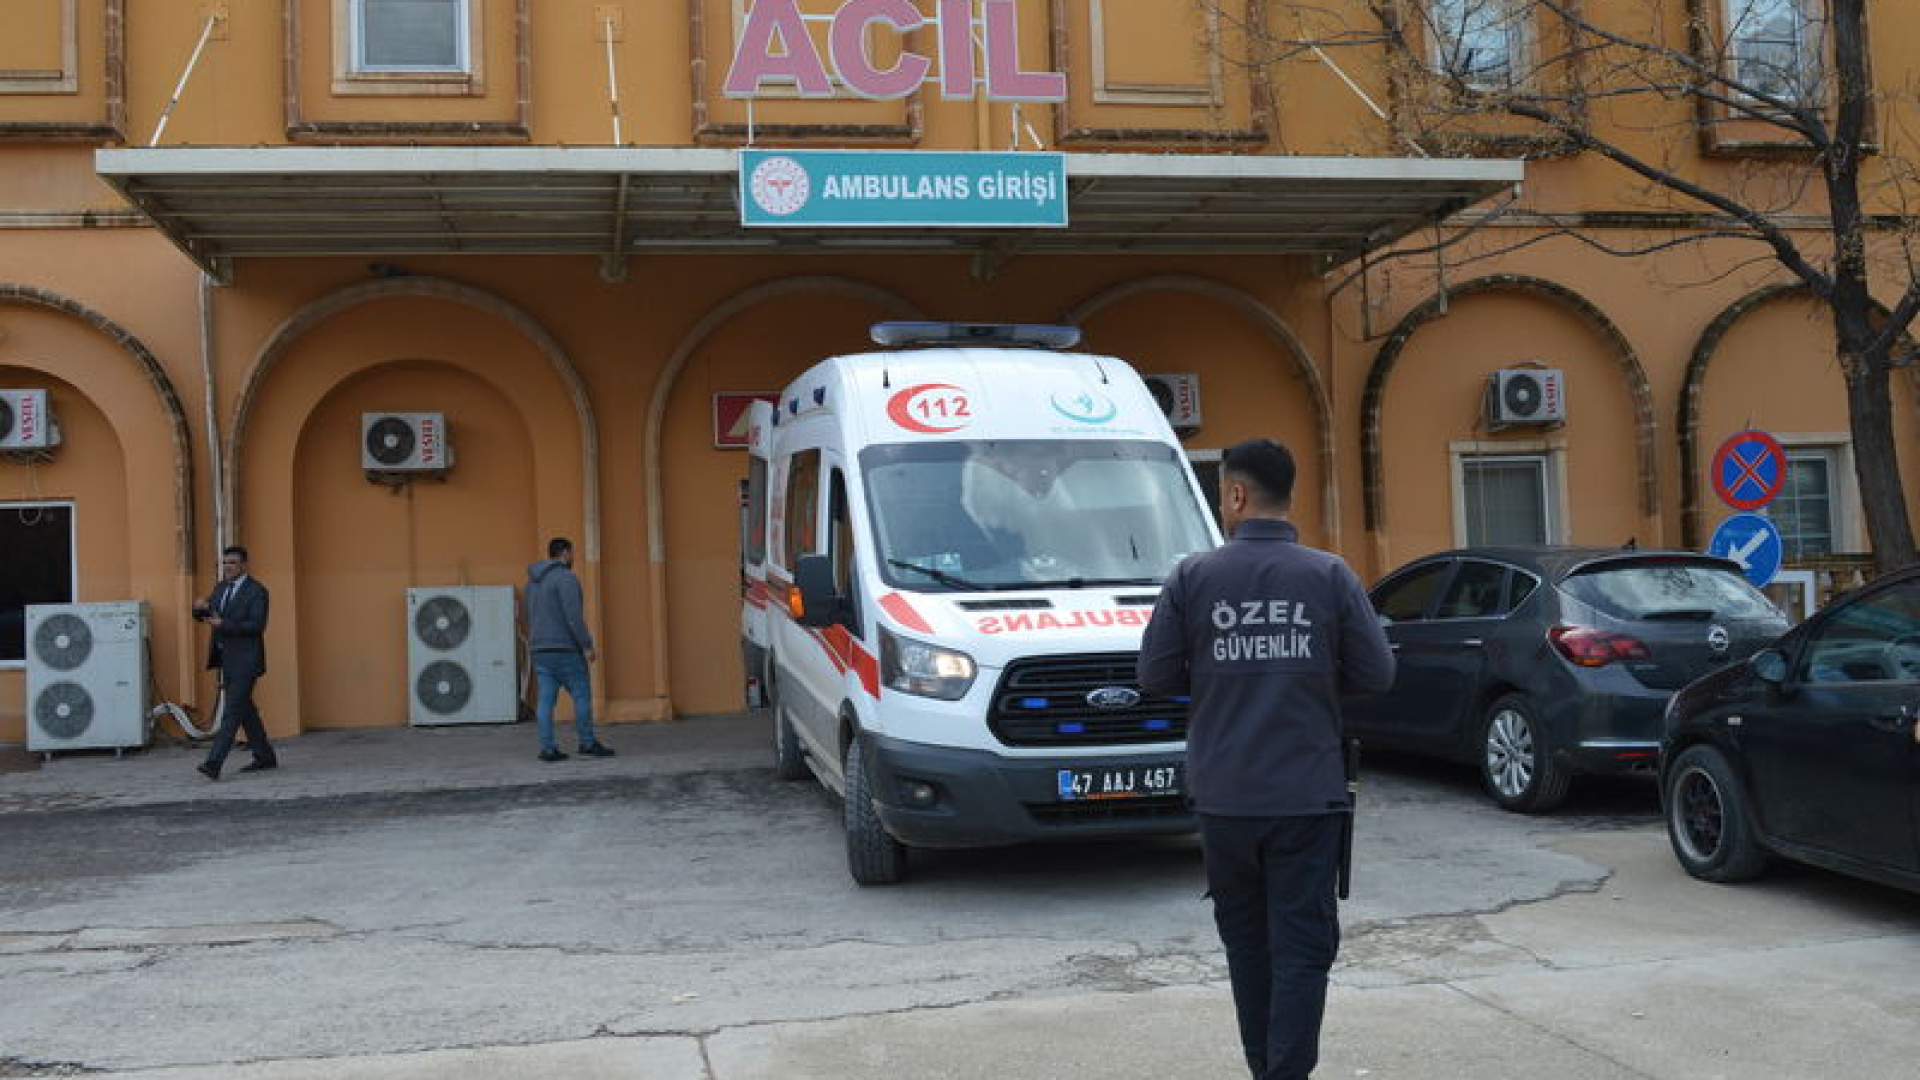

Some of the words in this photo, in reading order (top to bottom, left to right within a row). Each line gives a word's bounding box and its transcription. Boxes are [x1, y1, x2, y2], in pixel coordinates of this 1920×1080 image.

[822, 174, 971, 200] AMBULANS
[977, 170, 1057, 206] GİRİŞİ
[916, 395, 971, 418] 112
[1211, 599, 1312, 629] ÖZEL
[1213, 628, 1312, 661] GÜVENLİK
[1071, 772, 1093, 793] 47
[1103, 770, 1135, 792] AAJ
